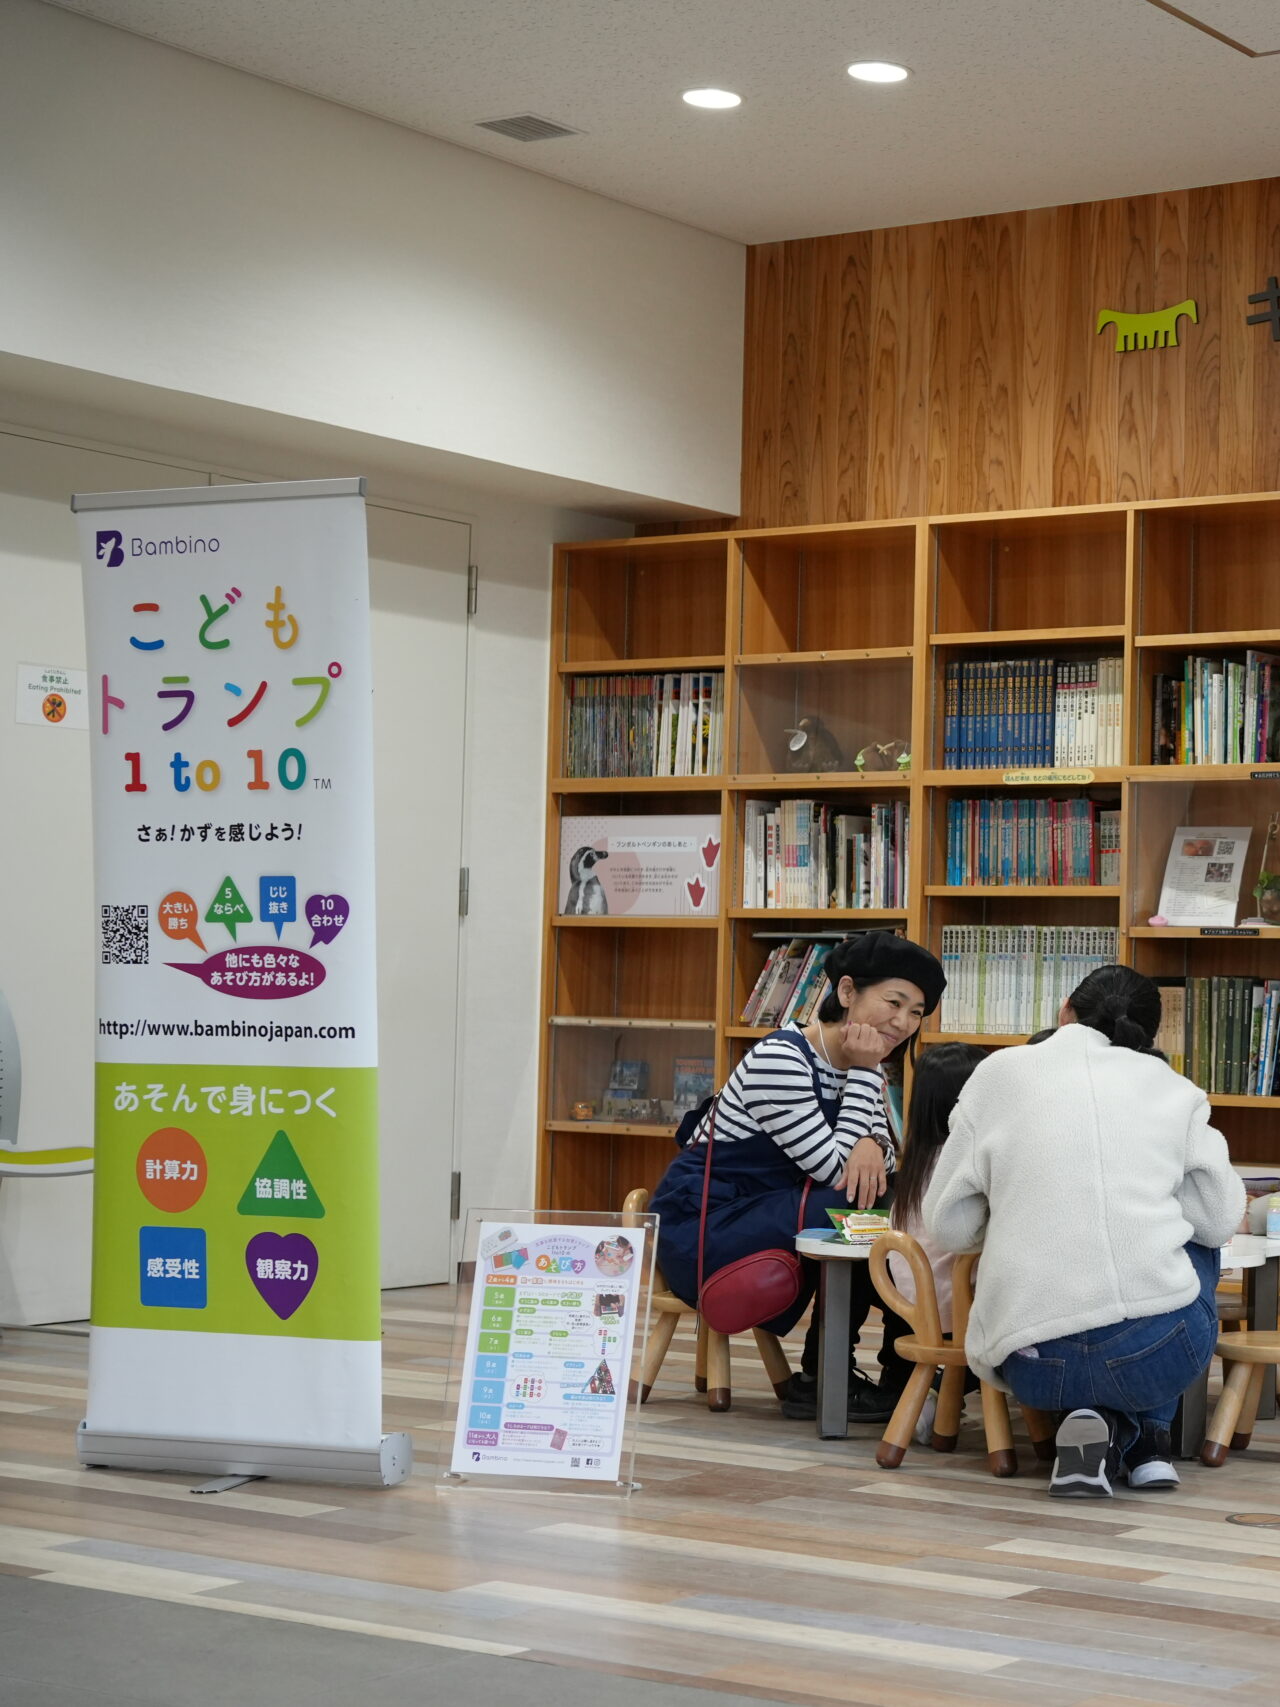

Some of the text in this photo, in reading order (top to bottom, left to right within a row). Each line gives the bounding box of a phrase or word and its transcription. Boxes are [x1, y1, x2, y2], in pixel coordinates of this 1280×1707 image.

[131, 534, 221, 558] Bambino
[129, 586, 299, 651] こども
[41, 674, 70, 685] 食事禁止
[28, 683, 82, 695] Eating Prohibited
[101, 661, 342, 736] トランプ
[124, 748, 332, 793] 1 to 10 TM
[225, 888, 232, 900] 5
[269, 886, 288, 899] じじ
[162, 902, 194, 915] 大きい
[214, 903, 245, 916] ならべ
[269, 902, 289, 916] 抜き
[320, 899, 334, 911] 10
[168, 917, 189, 931] 勝ち
[311, 914, 345, 928] 合わせ
[225, 952, 300, 969] 他にも色々な
[99, 1018, 356, 1042] http://www.bambinojapan.com
[113, 1081, 337, 1118] あそんで身につく
[145, 1159, 199, 1182] 計算力
[254, 1178, 307, 1200] 協調性
[147, 1258, 200, 1279] 感受性
[256, 1259, 309, 1281] 観察力
[538, 1258, 583, 1273] あそび方
